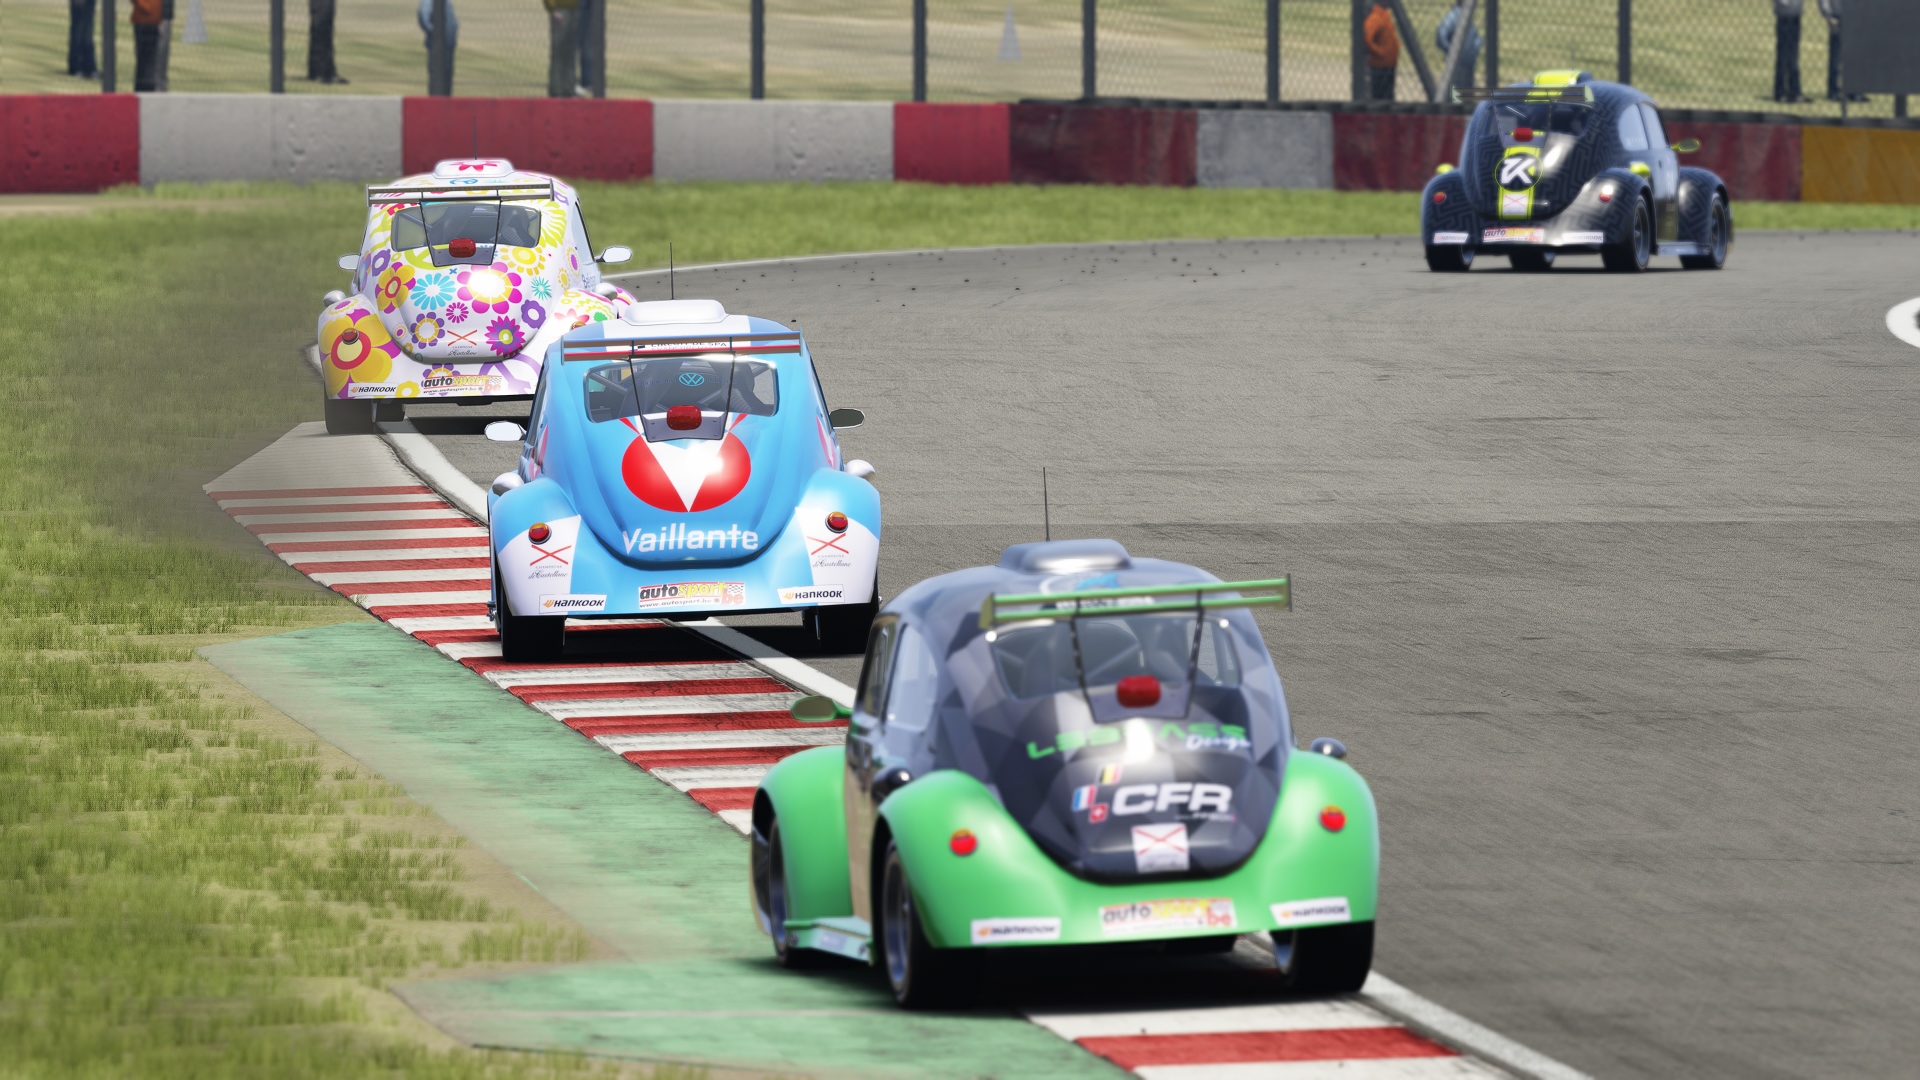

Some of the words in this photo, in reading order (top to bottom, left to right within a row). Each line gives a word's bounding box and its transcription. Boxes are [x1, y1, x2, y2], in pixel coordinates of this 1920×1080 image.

[424, 375, 490, 388] autosport
[622, 522, 759, 555] Vaillante
[640, 582, 728, 599] autosport
[640, 598, 712, 608] www.autosport.be
[1111, 782, 1233, 816] CFR
